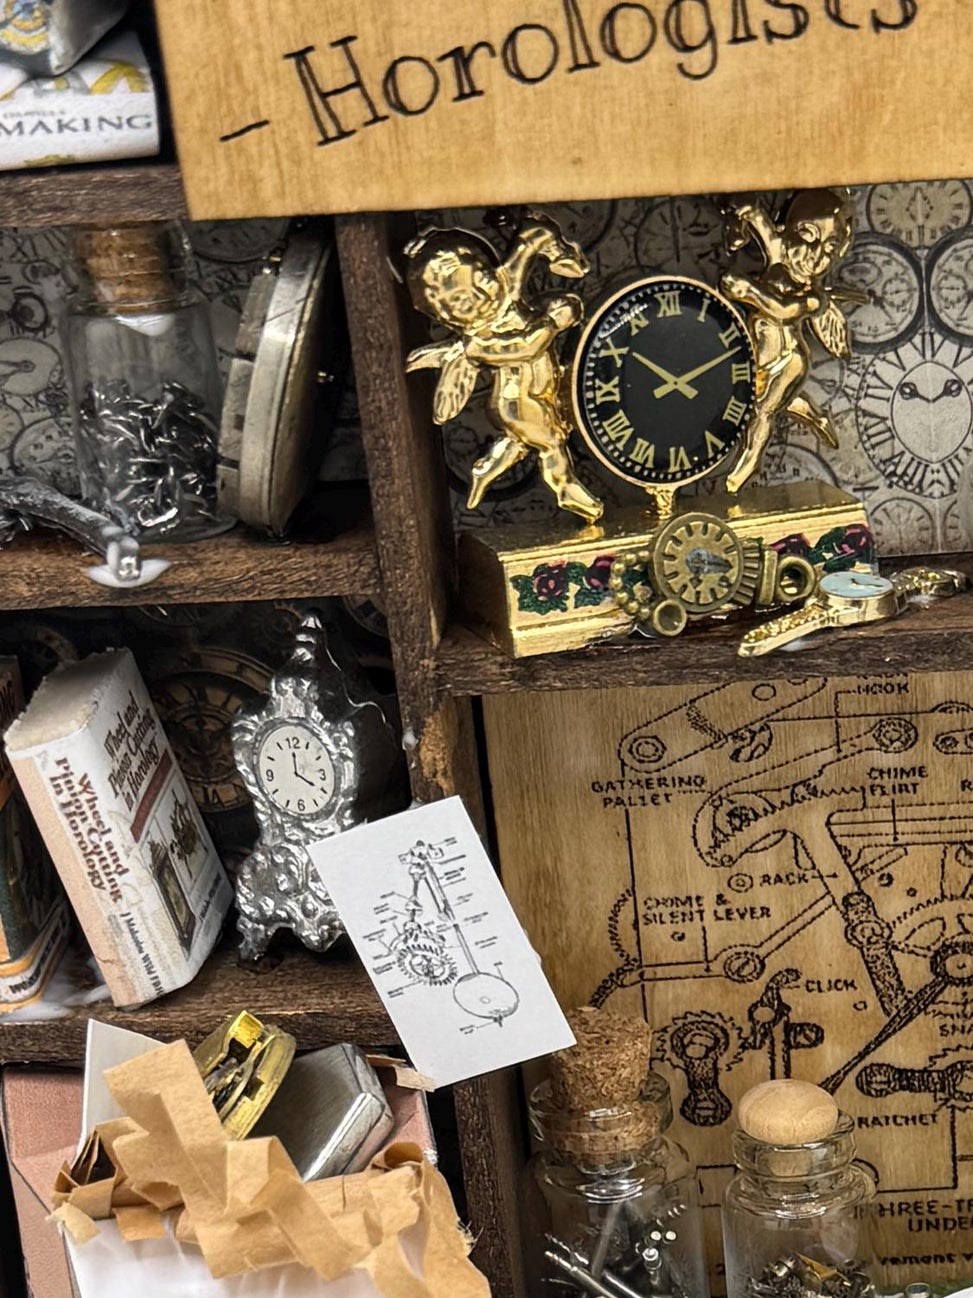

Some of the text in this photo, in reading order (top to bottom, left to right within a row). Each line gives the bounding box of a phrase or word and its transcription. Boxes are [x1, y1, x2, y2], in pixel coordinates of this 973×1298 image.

[654, 291, 683, 318] XII
[697, 298, 711, 322] I
[718, 323, 742, 349] II
[599, 338, 630, 368] X
[732, 363, 751, 384] III
[595, 376, 621, 405] IX
[722, 396, 748, 426] IIII
[602, 409, 635, 452] VIII
[629, 438, 655, 468] VII
[705, 430, 725, 458] V
[667, 446, 692, 473] VI
[285, 736, 301, 749] 12
[265, 769, 274, 782] 9
[318, 768, 326, 781] 3
[591, 775, 706, 793] GATHERING
[867, 766, 928, 780] CHIME
[297, 798, 306, 811] 6
[55, 756, 91, 827] Pinion
[87, 825, 123, 904] Cutting
[77, 771, 113, 842] Wheel
[105, 839, 130, 879] and
[60, 800, 107, 893] Horology
[760, 872, 810, 887] RACK
[715, 893, 730, 906] &
[643, 906, 772, 925] SILENT LEVER
[805, 979, 859, 993] CLICK
[857, 1113, 938, 1129] RATCHET
